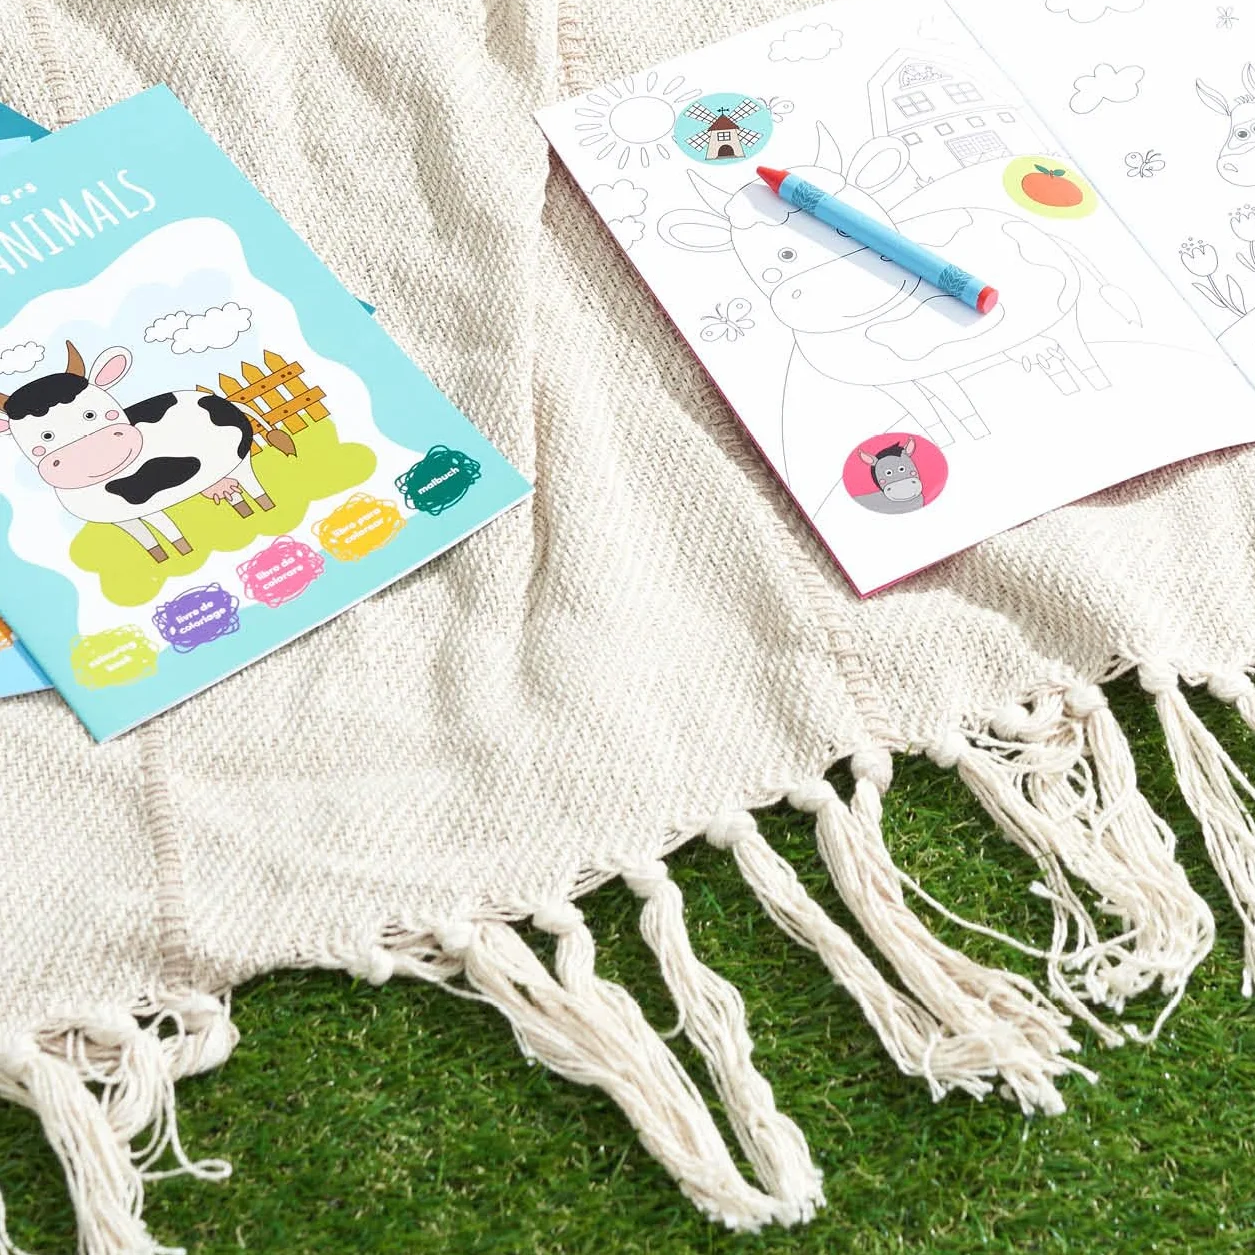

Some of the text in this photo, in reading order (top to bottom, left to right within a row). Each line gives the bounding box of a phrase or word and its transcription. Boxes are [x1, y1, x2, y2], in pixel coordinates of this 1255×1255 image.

[417, 466, 460, 495] malbuch
[255, 566, 281, 581] libro
[262, 564, 304, 591] colorare
[175, 600, 215, 625] livre de
[179, 607, 227, 635] coloriage
